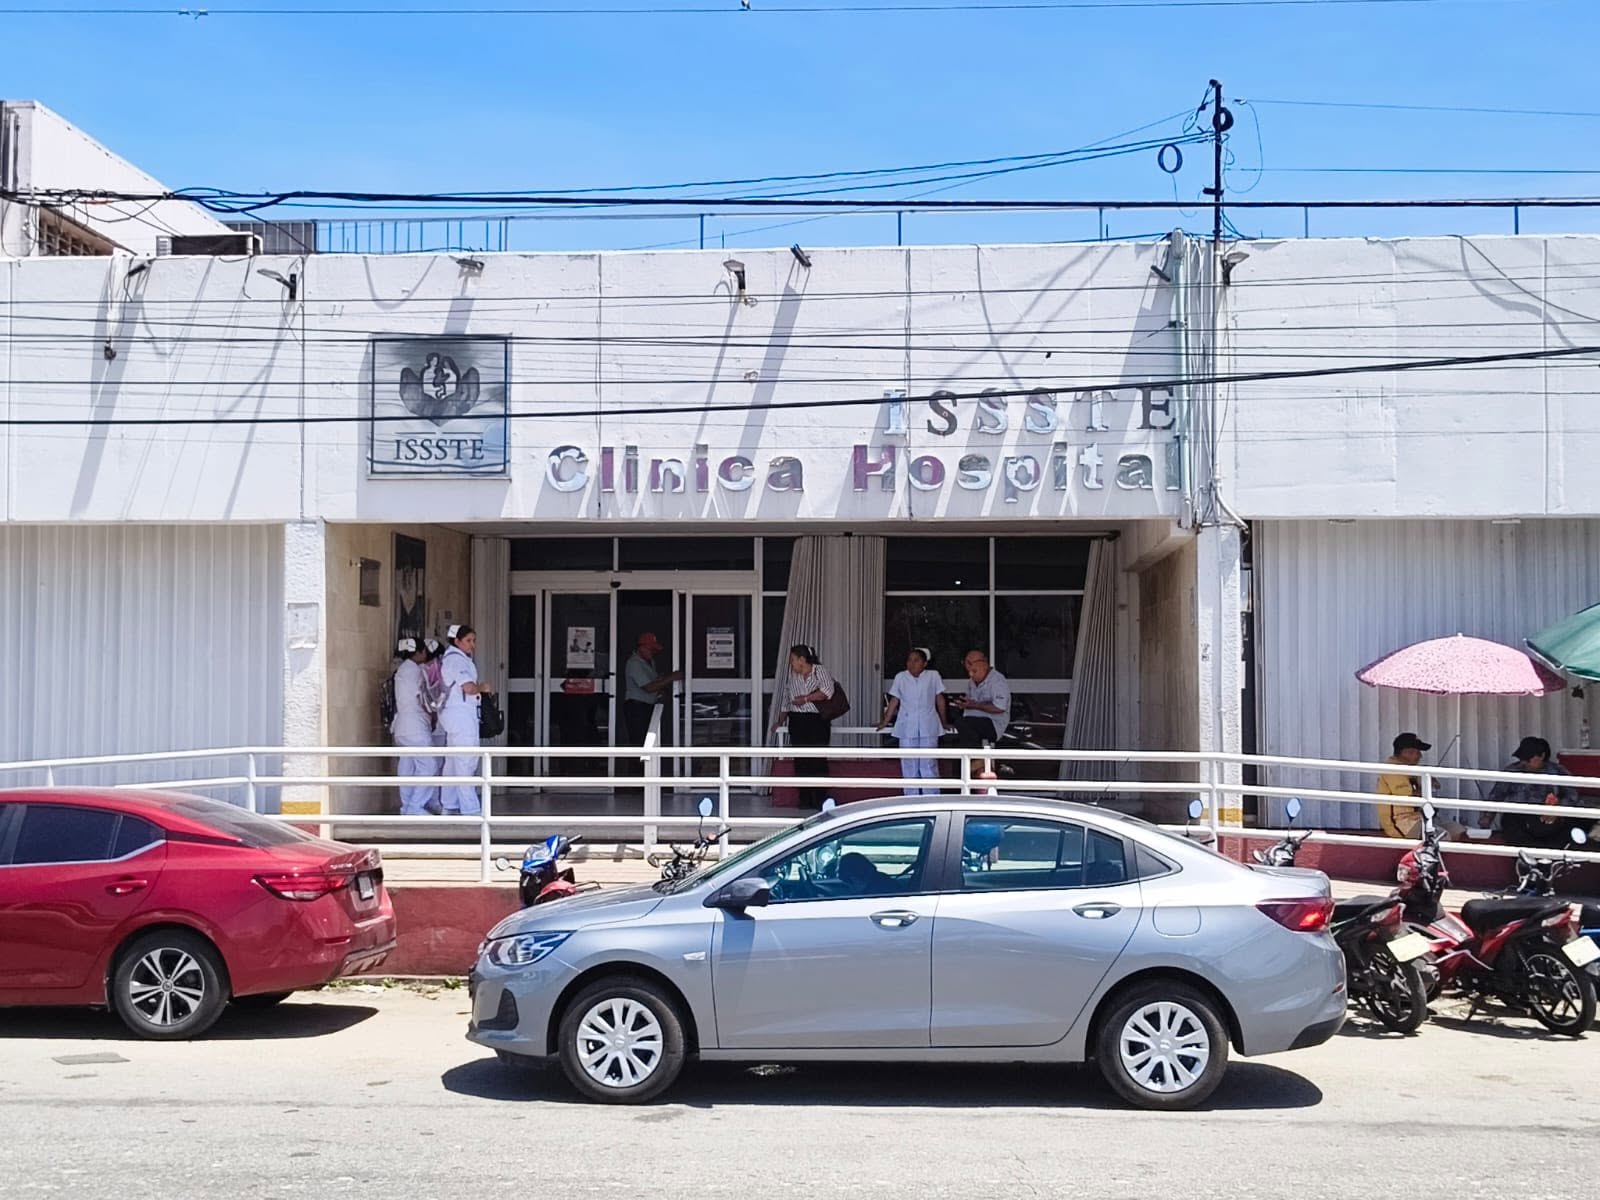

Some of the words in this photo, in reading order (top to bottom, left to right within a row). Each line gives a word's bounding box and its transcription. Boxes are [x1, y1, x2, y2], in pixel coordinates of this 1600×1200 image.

[883, 387, 1176, 436] ISSSTE
[393, 438, 485, 460] ISSSTE
[545, 443, 804, 493] Clinica
[853, 441, 1180, 503] Hospital
